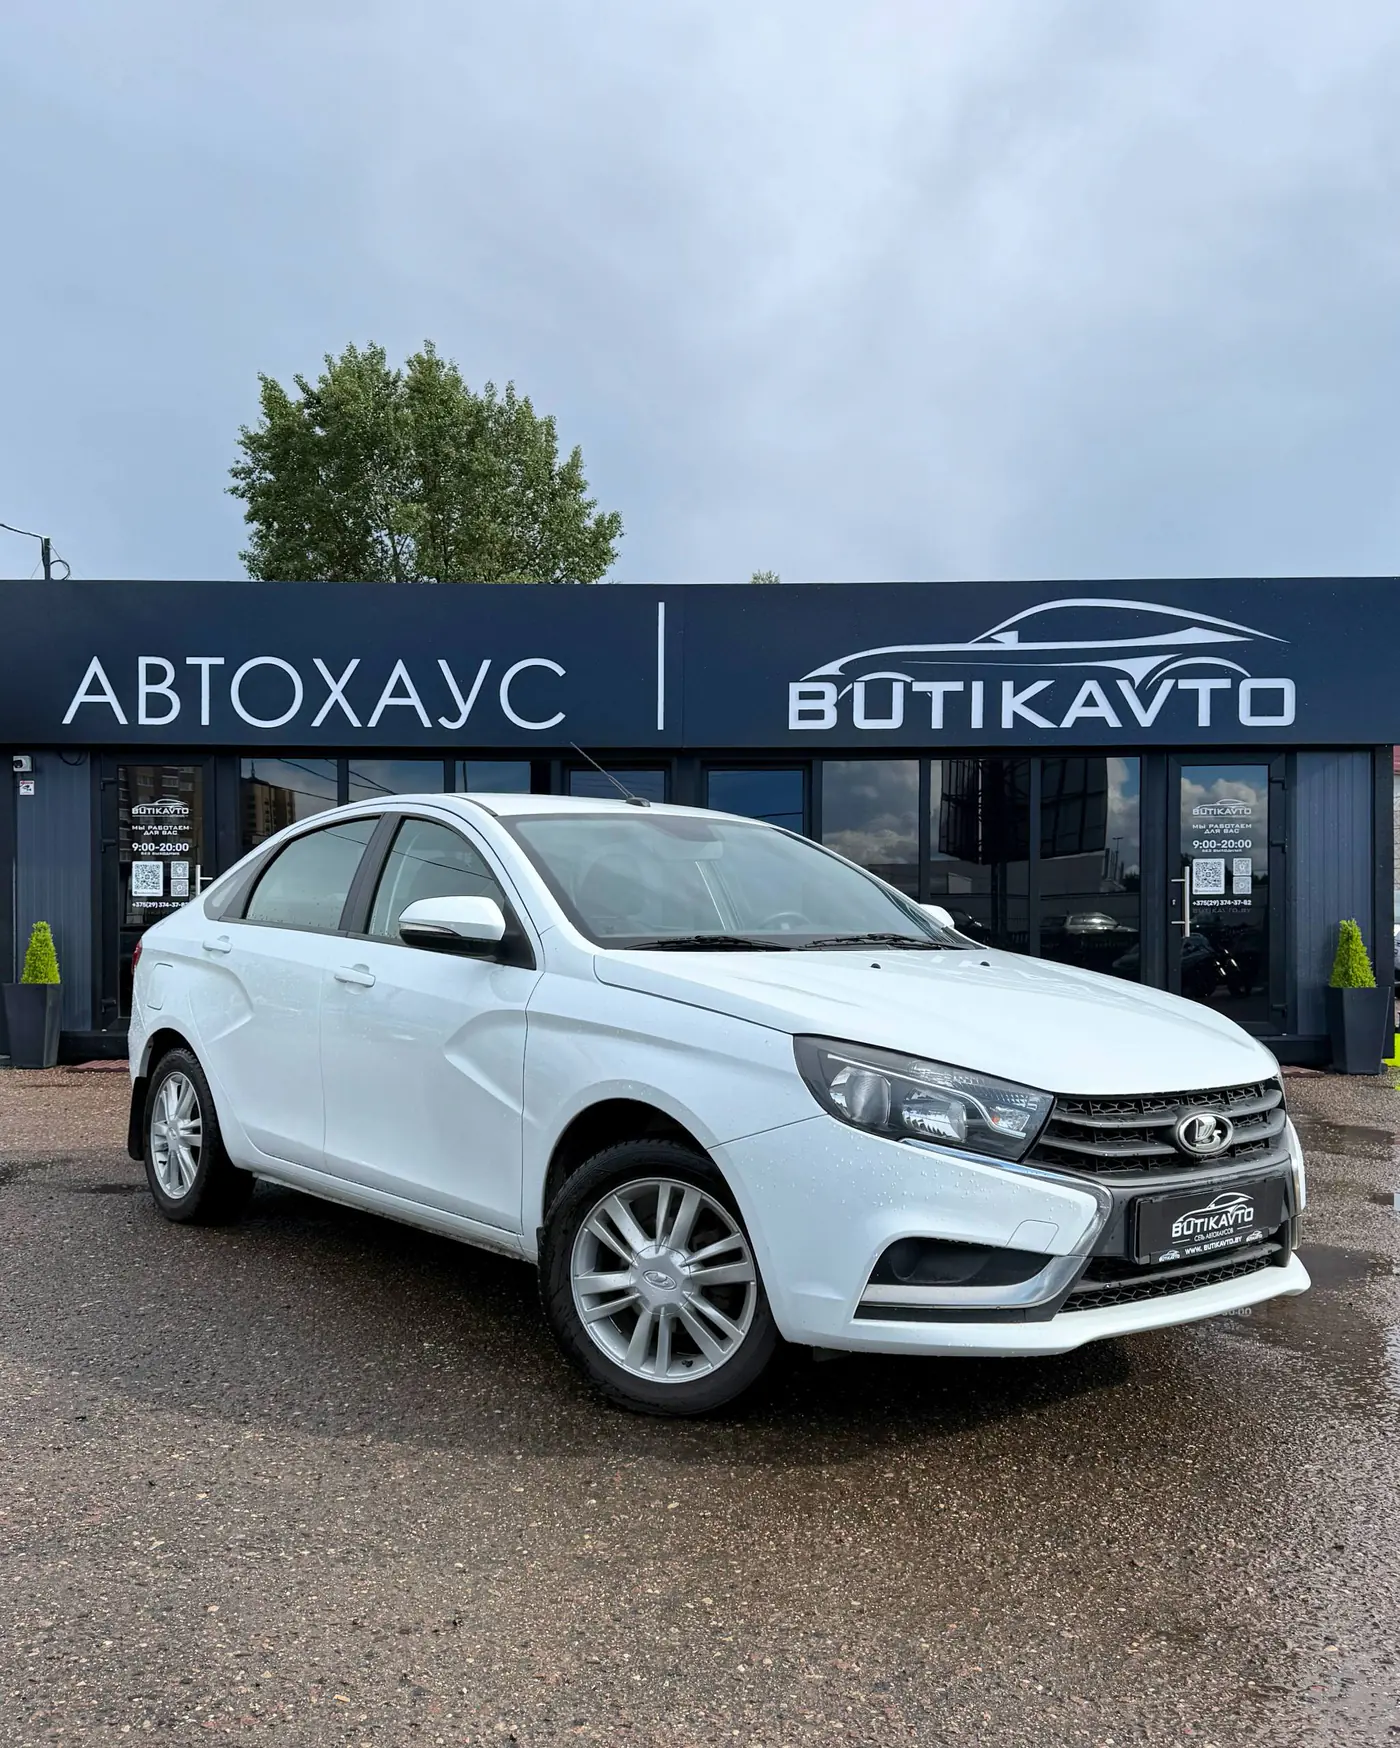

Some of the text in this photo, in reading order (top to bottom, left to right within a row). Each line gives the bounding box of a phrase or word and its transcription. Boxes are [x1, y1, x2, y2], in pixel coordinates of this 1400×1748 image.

[62, 655, 567, 731] АВТОХАУС
[788, 677, 1297, 730] BUTIKAVTO
[131, 807, 189, 815] BUTIKAVTO
[1192, 807, 1252, 816] BUTIKAVTO
[131, 842, 190, 852] 9:00-20:00
[1192, 839, 1252, 849] 9:00-20:00
[1171, 1207, 1254, 1238] BUTIKAVTO
